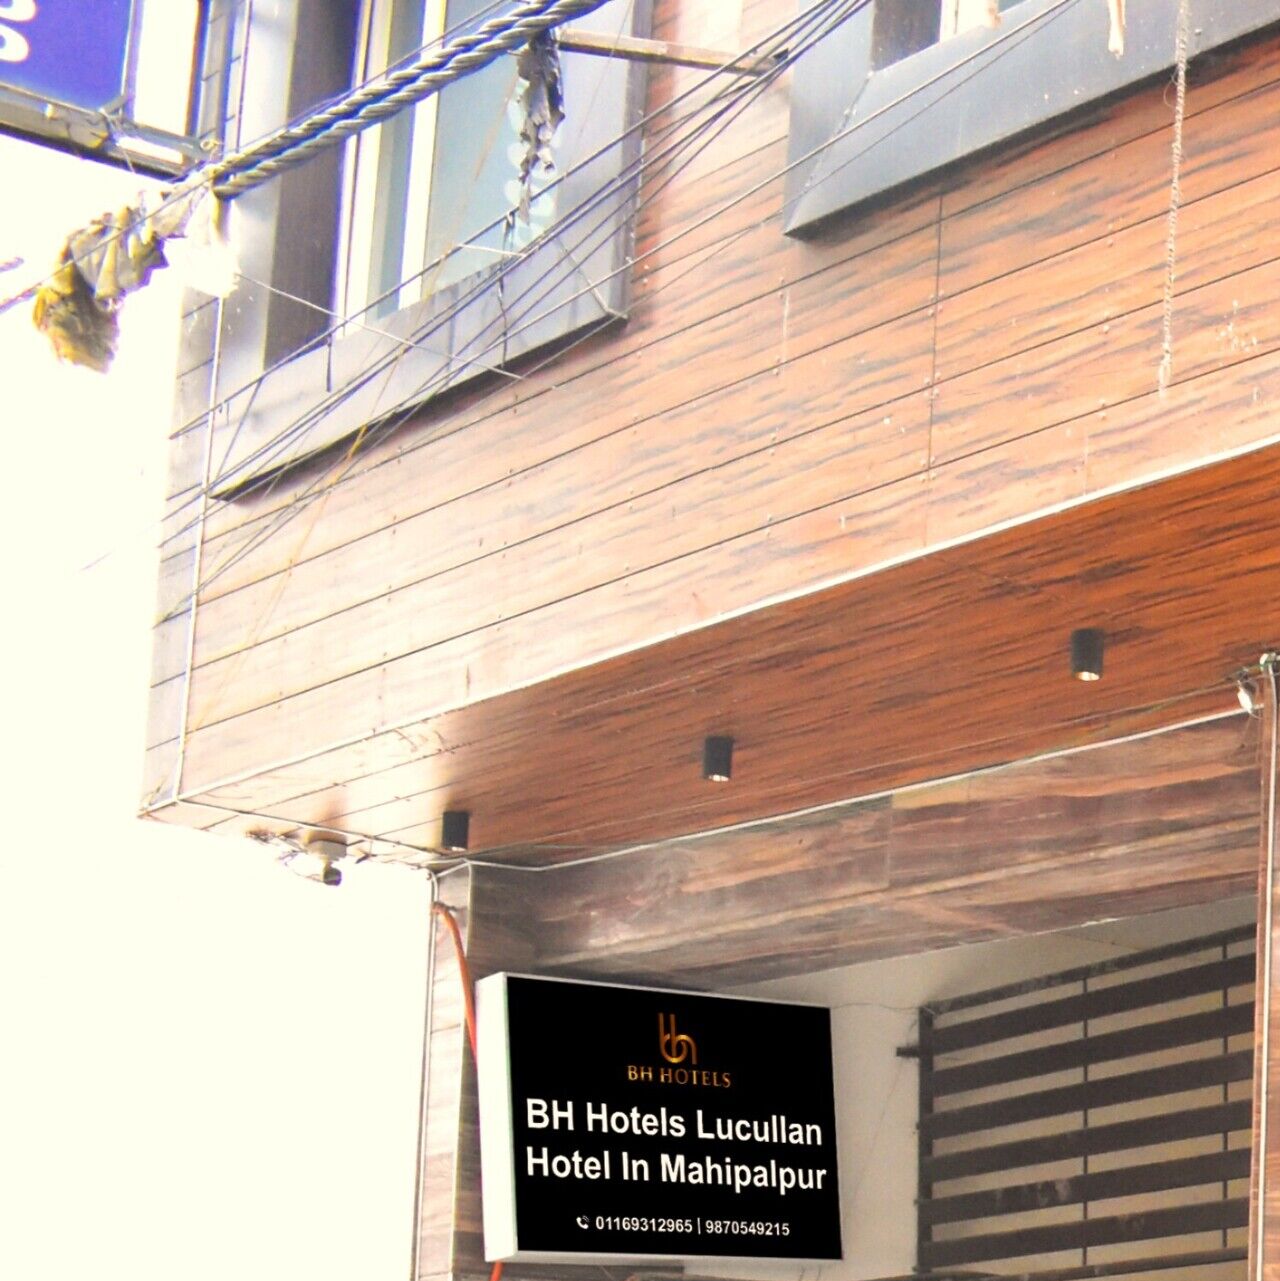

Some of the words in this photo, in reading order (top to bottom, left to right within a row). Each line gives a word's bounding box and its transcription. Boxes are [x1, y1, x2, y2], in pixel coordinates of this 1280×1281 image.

[627, 1064, 653, 1082] BH
[659, 1066, 732, 1088] HOTELS
[526, 1097, 575, 1131] BH
[586, 1101, 686, 1138] Hotels
[696, 1109, 822, 1146] Lucullan
[526, 1146, 611, 1180] Hotel
[621, 1151, 650, 1182] In
[660, 1153, 827, 1196] Mahipalpur
[595, 1215, 693, 1233] 01169312965
[705, 1219, 790, 1236] 9870549215
